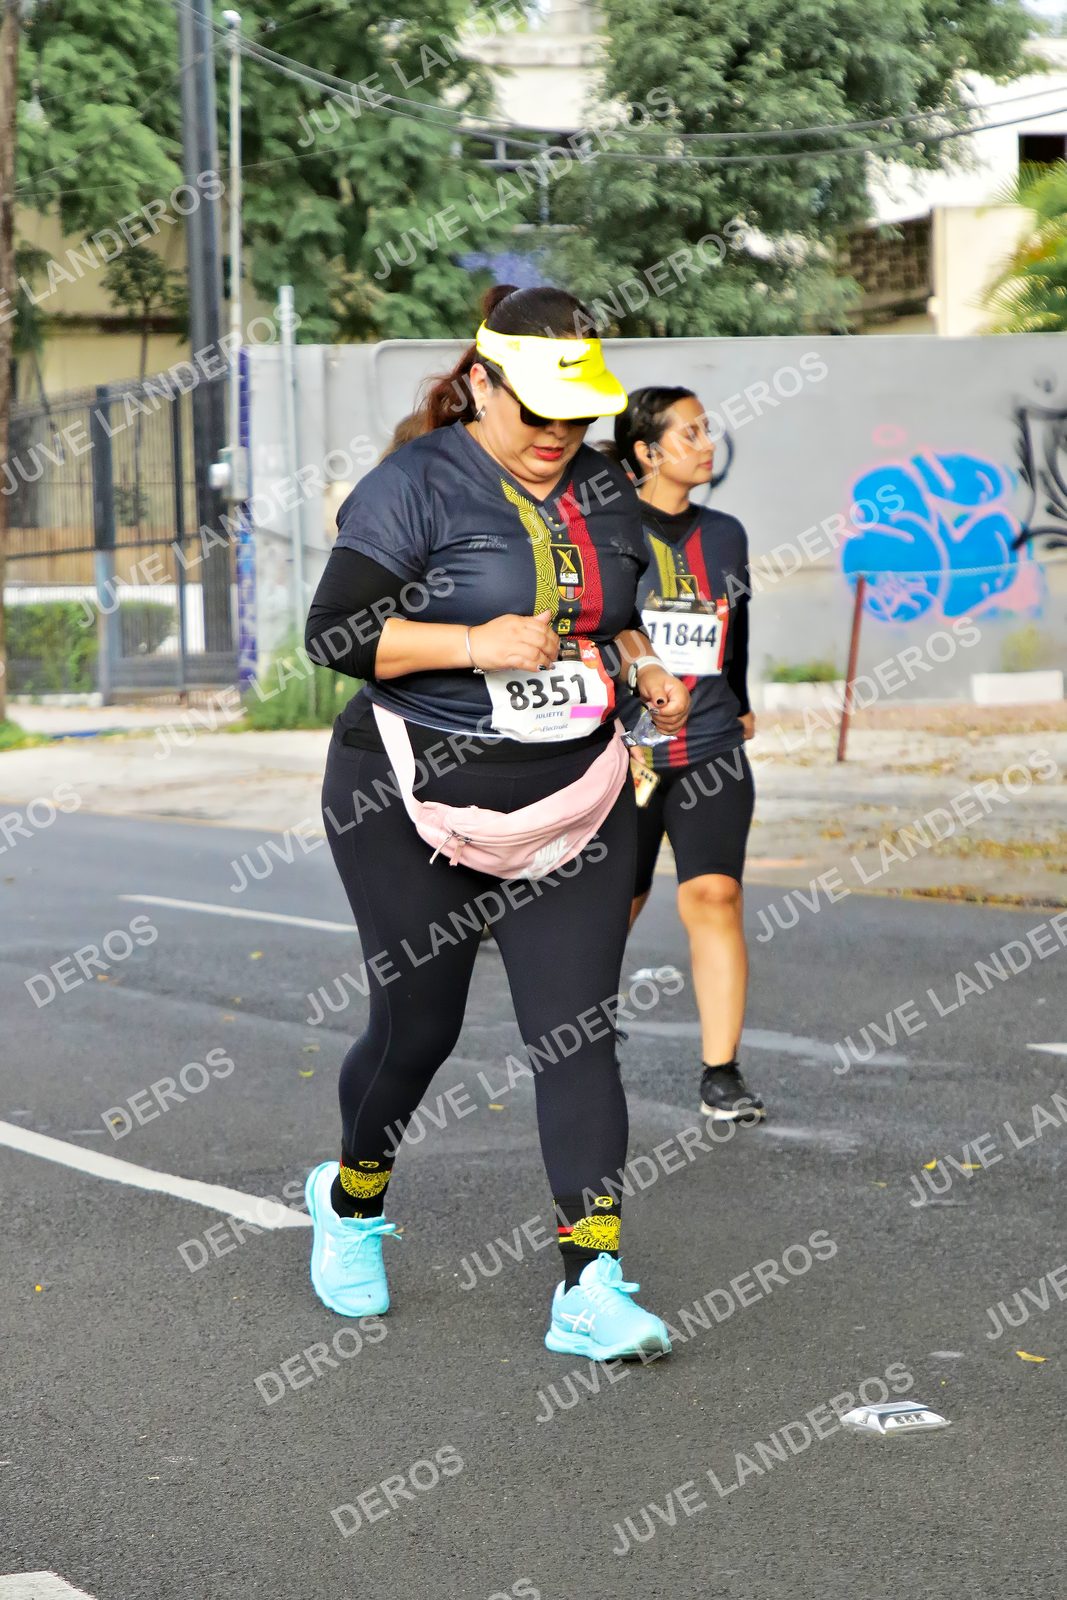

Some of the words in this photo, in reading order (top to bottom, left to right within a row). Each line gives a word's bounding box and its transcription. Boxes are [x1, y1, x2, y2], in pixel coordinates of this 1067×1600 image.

[648, 622, 717, 648] 11844
[506, 674, 588, 711] 8351
[536, 711, 564, 720] JULIETTE
